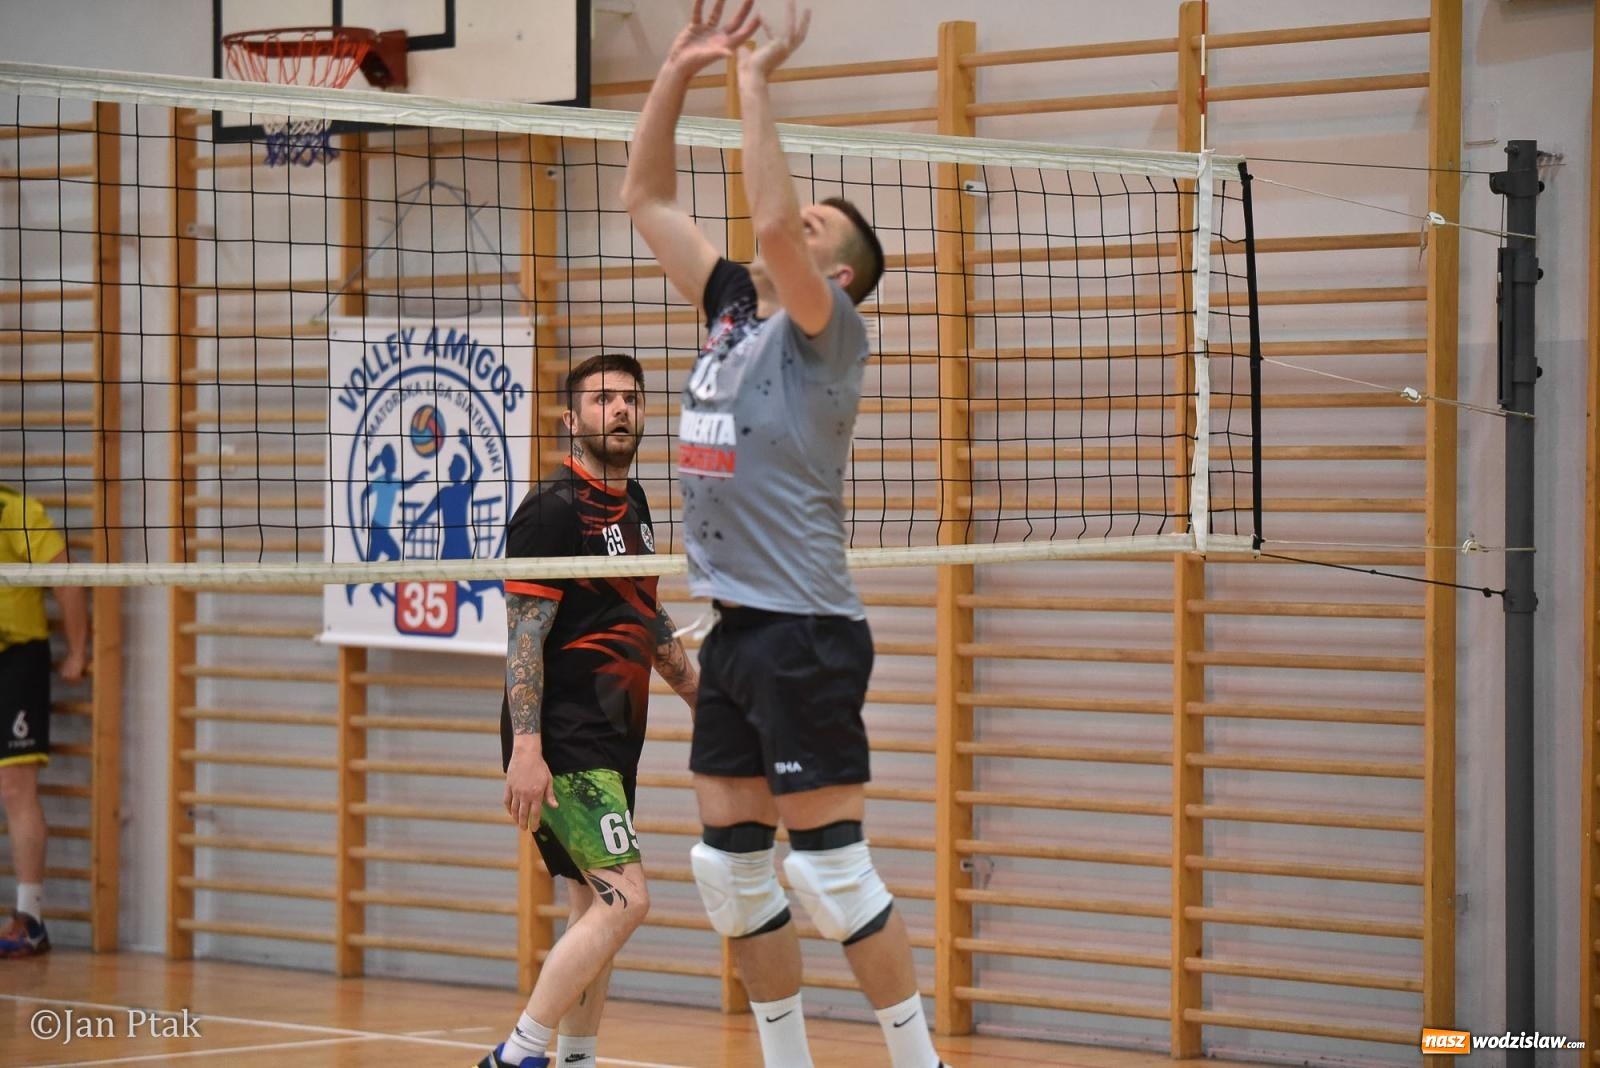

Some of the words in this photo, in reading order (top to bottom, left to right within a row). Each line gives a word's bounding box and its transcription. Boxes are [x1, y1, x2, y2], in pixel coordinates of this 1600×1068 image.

[338, 326, 416, 413] VOLLEY
[423, 326, 524, 413] AMIGOS
[602, 523, 626, 557] 69
[403, 582, 448, 629] 35
[12, 709, 29, 739] 6
